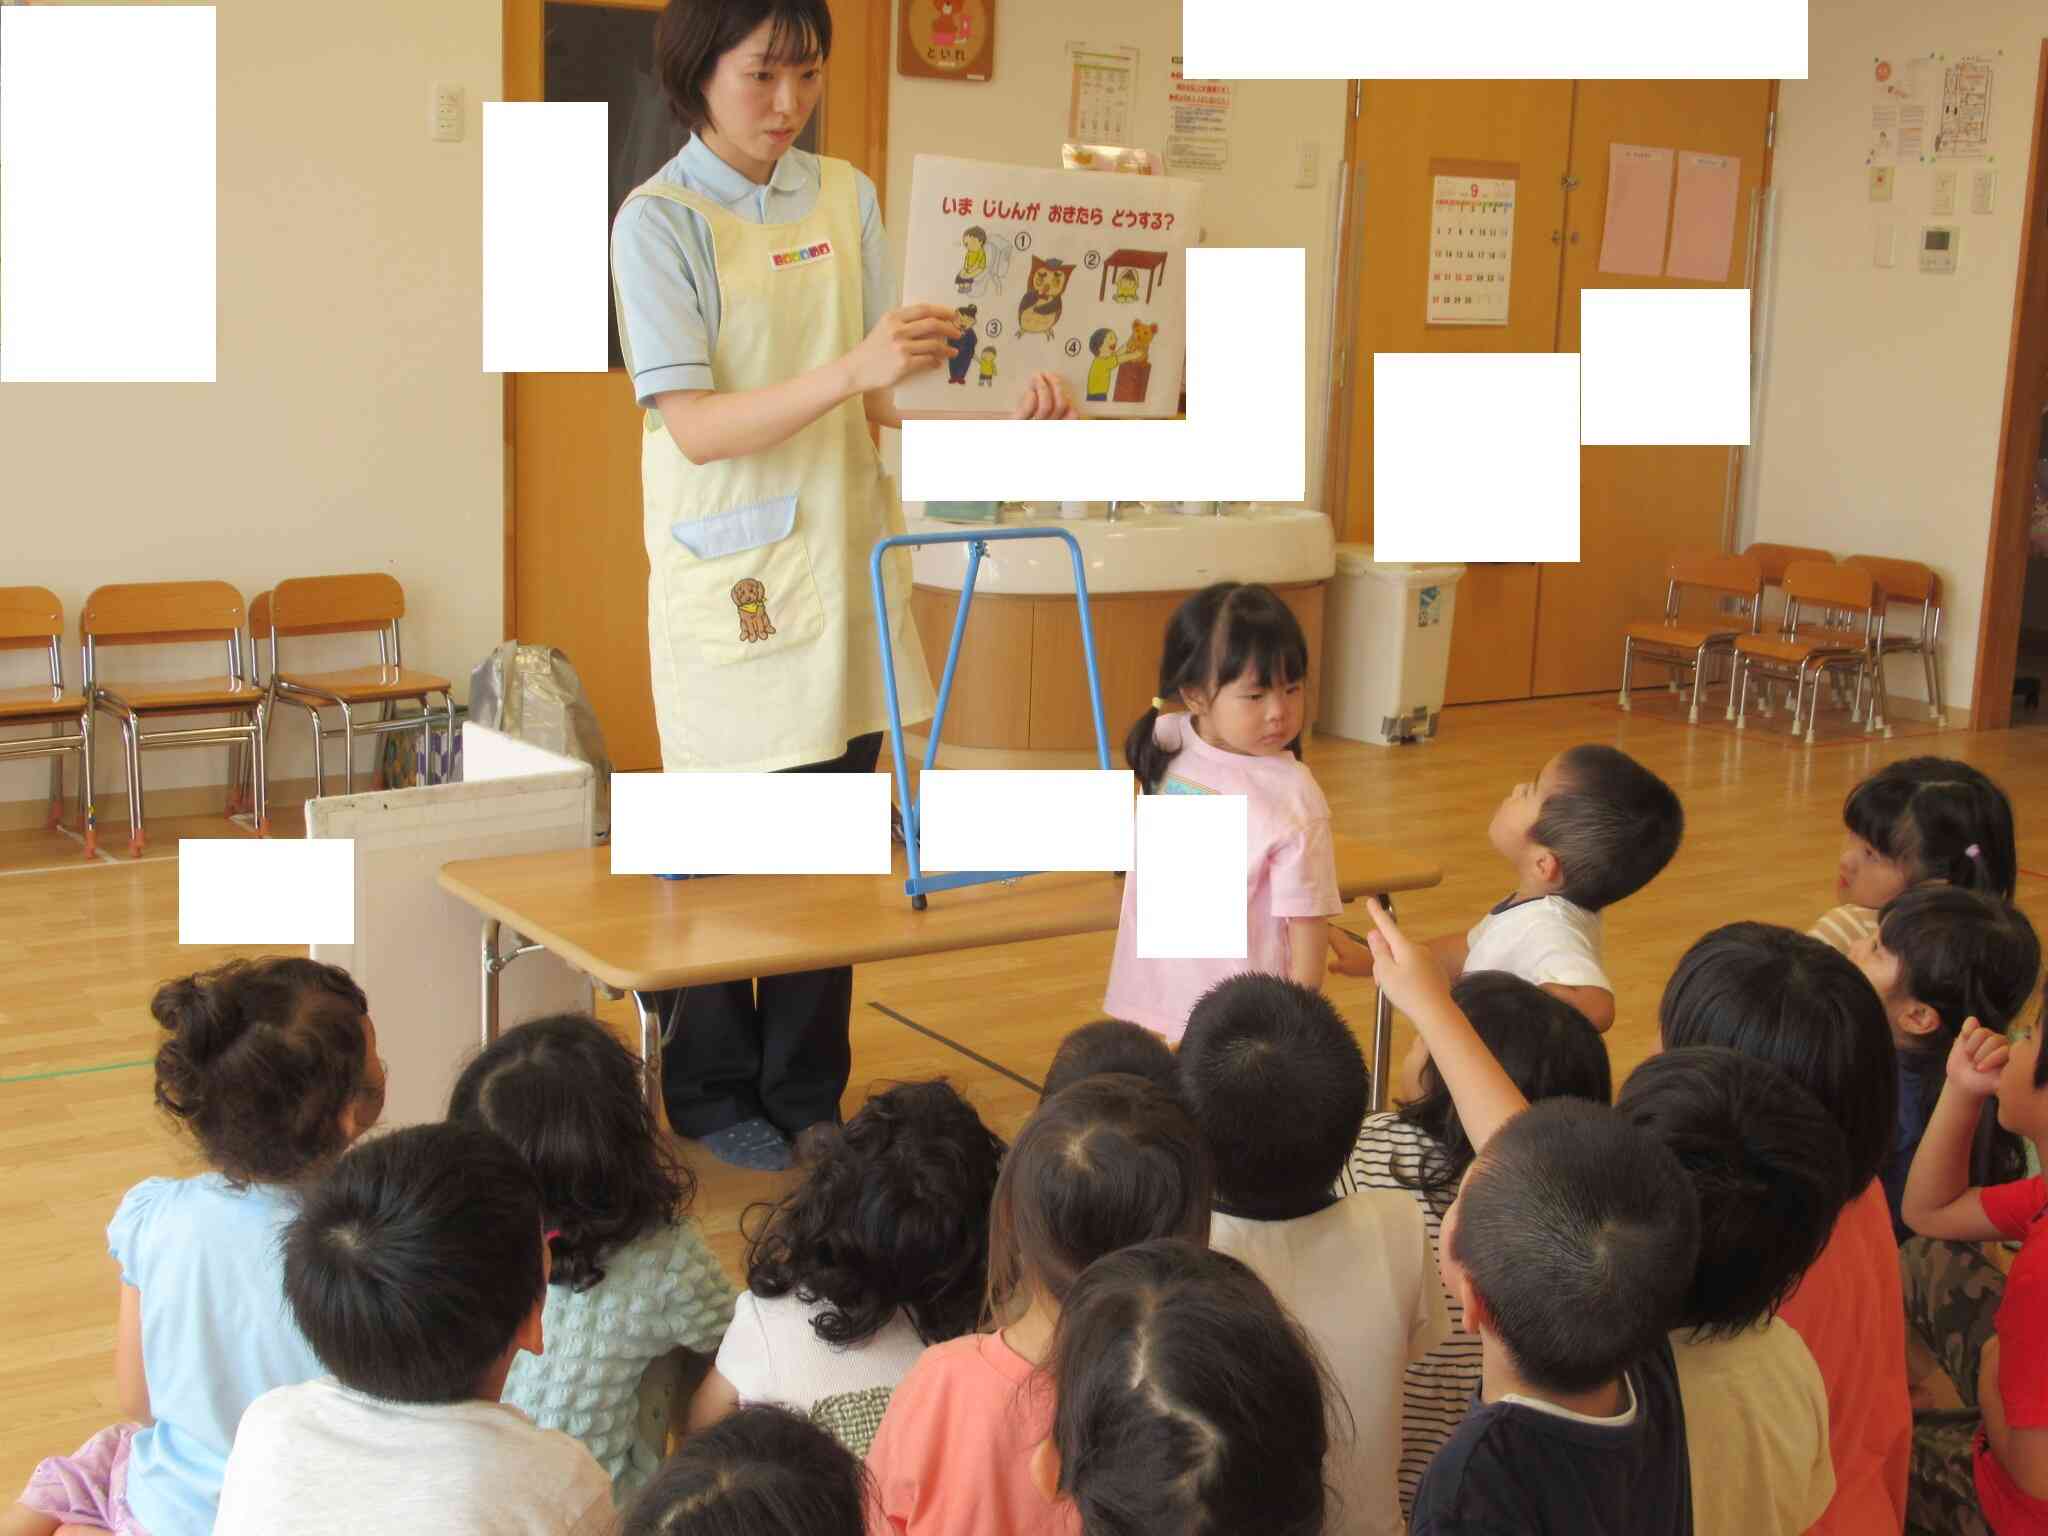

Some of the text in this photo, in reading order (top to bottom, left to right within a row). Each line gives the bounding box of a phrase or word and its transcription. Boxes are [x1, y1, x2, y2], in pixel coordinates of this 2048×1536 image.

[942, 196, 973, 216] いま
[983, 199, 1041, 221] じしんが
[1048, 204, 1104, 225] おきたら
